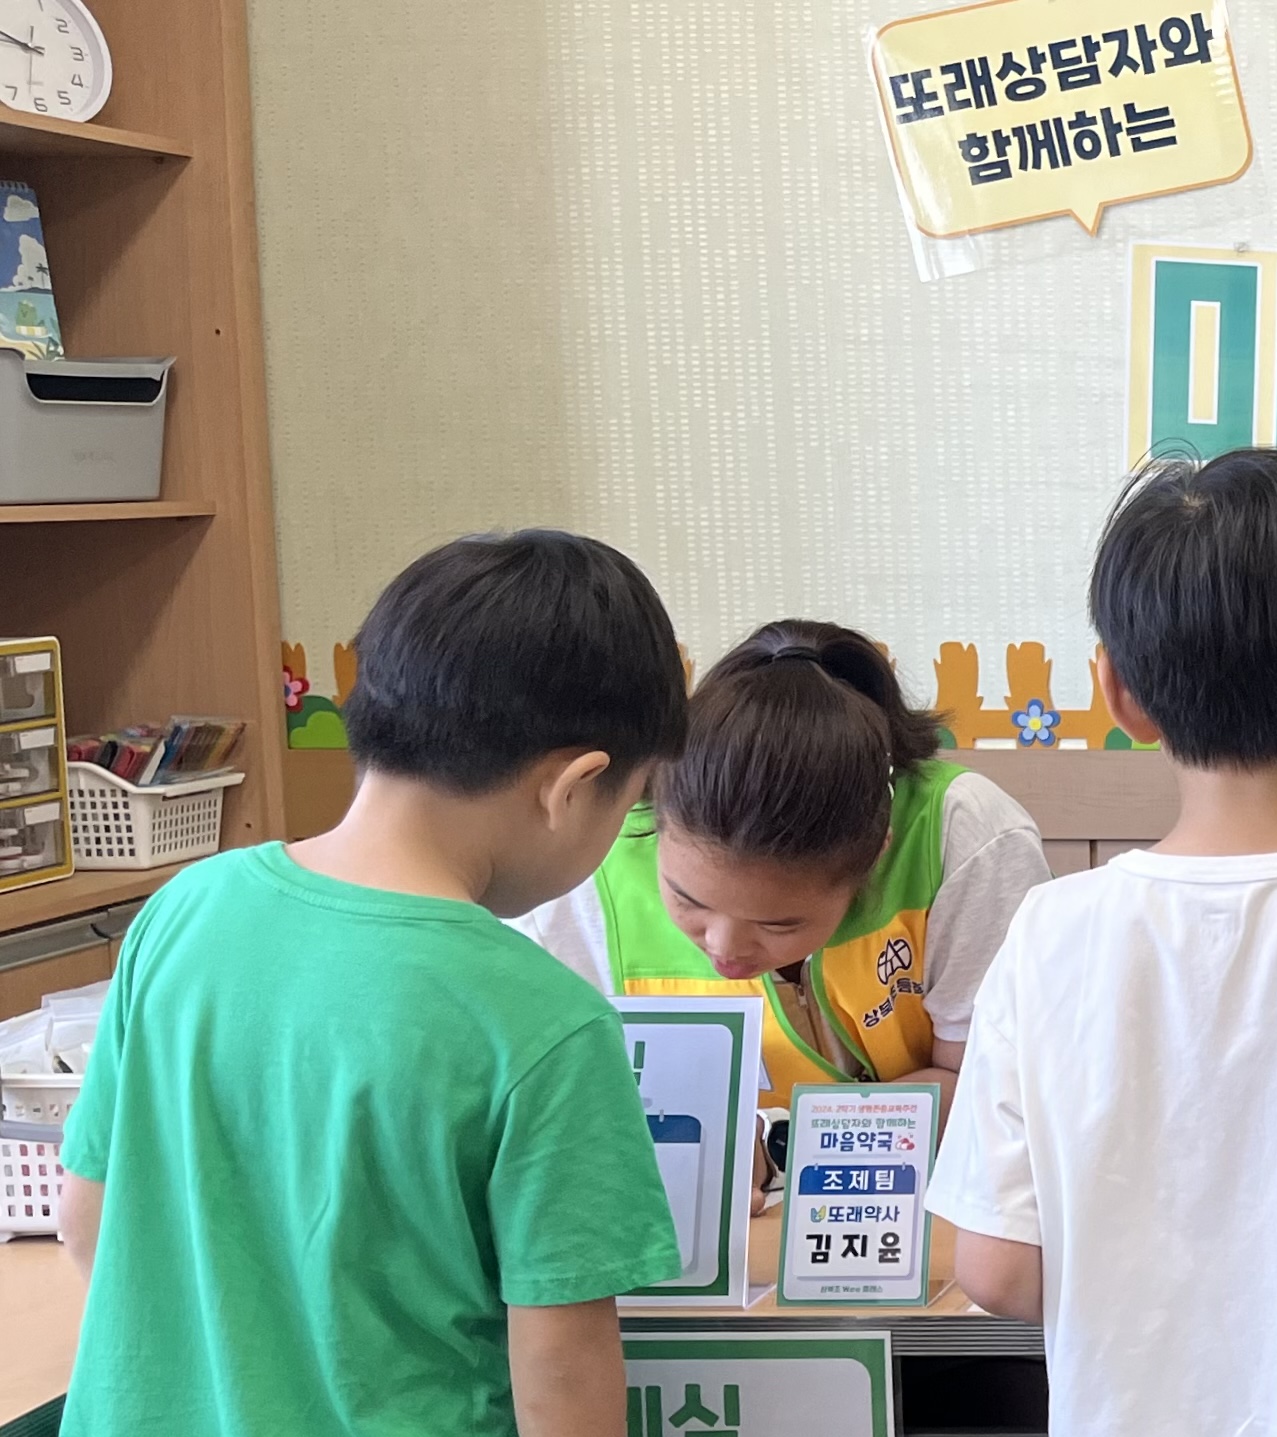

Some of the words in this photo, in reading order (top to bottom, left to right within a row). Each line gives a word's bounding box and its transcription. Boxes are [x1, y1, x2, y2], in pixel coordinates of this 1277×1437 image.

[55, 17, 70, 34] 2
[69, 45, 85, 62] 3
[888, 12, 1214, 126] 또래상담자와
[70, 73, 84, 89] 4
[4, 84, 19, 102] 7
[56, 89, 72, 106] 5
[33, 97, 49, 113] 6
[958, 102, 1178, 186] 함께하는
[820, 1131, 894, 1153] 마음약국
[827, 1204, 901, 1224] 또래약사
